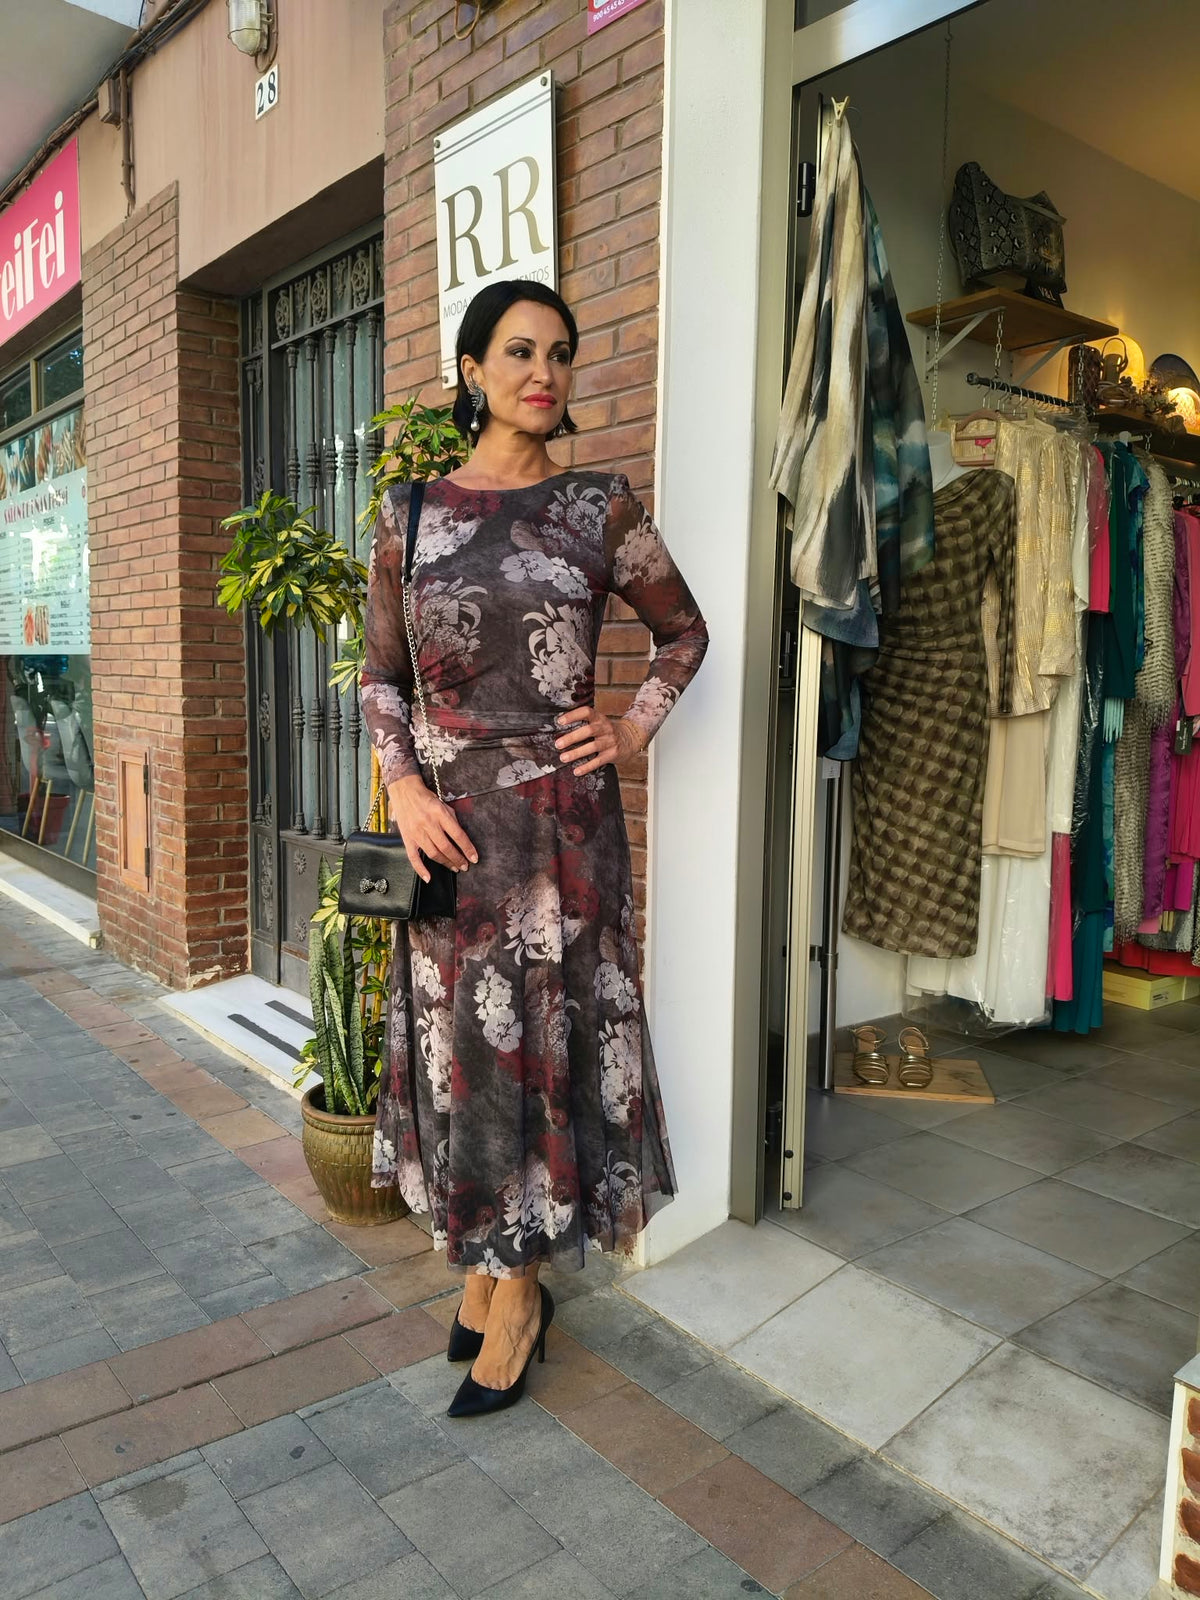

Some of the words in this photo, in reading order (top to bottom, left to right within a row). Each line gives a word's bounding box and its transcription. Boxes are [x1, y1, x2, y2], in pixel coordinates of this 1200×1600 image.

[257, 71, 276, 115] 28
[0, 190, 66, 321] eiFei
[443, 297, 468, 319] MODA
